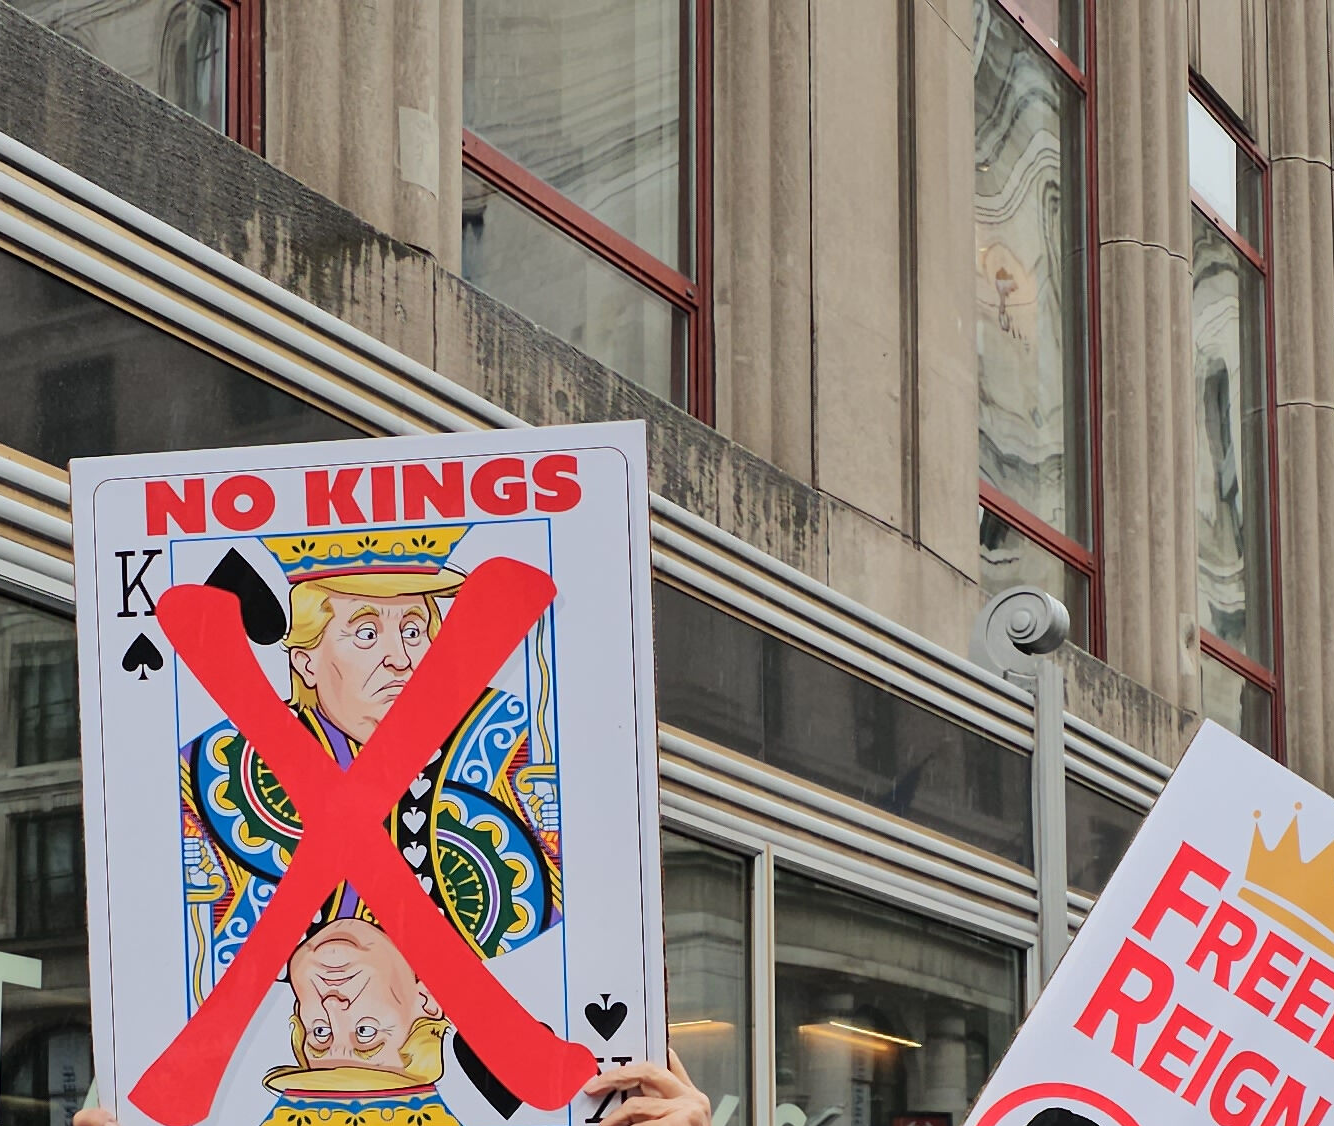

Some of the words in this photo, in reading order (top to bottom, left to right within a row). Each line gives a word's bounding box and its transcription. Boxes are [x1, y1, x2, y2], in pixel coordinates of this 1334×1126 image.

[145, 474, 276, 537] NO
[305, 454, 582, 528] KINGS
[115, 549, 164, 618] K
